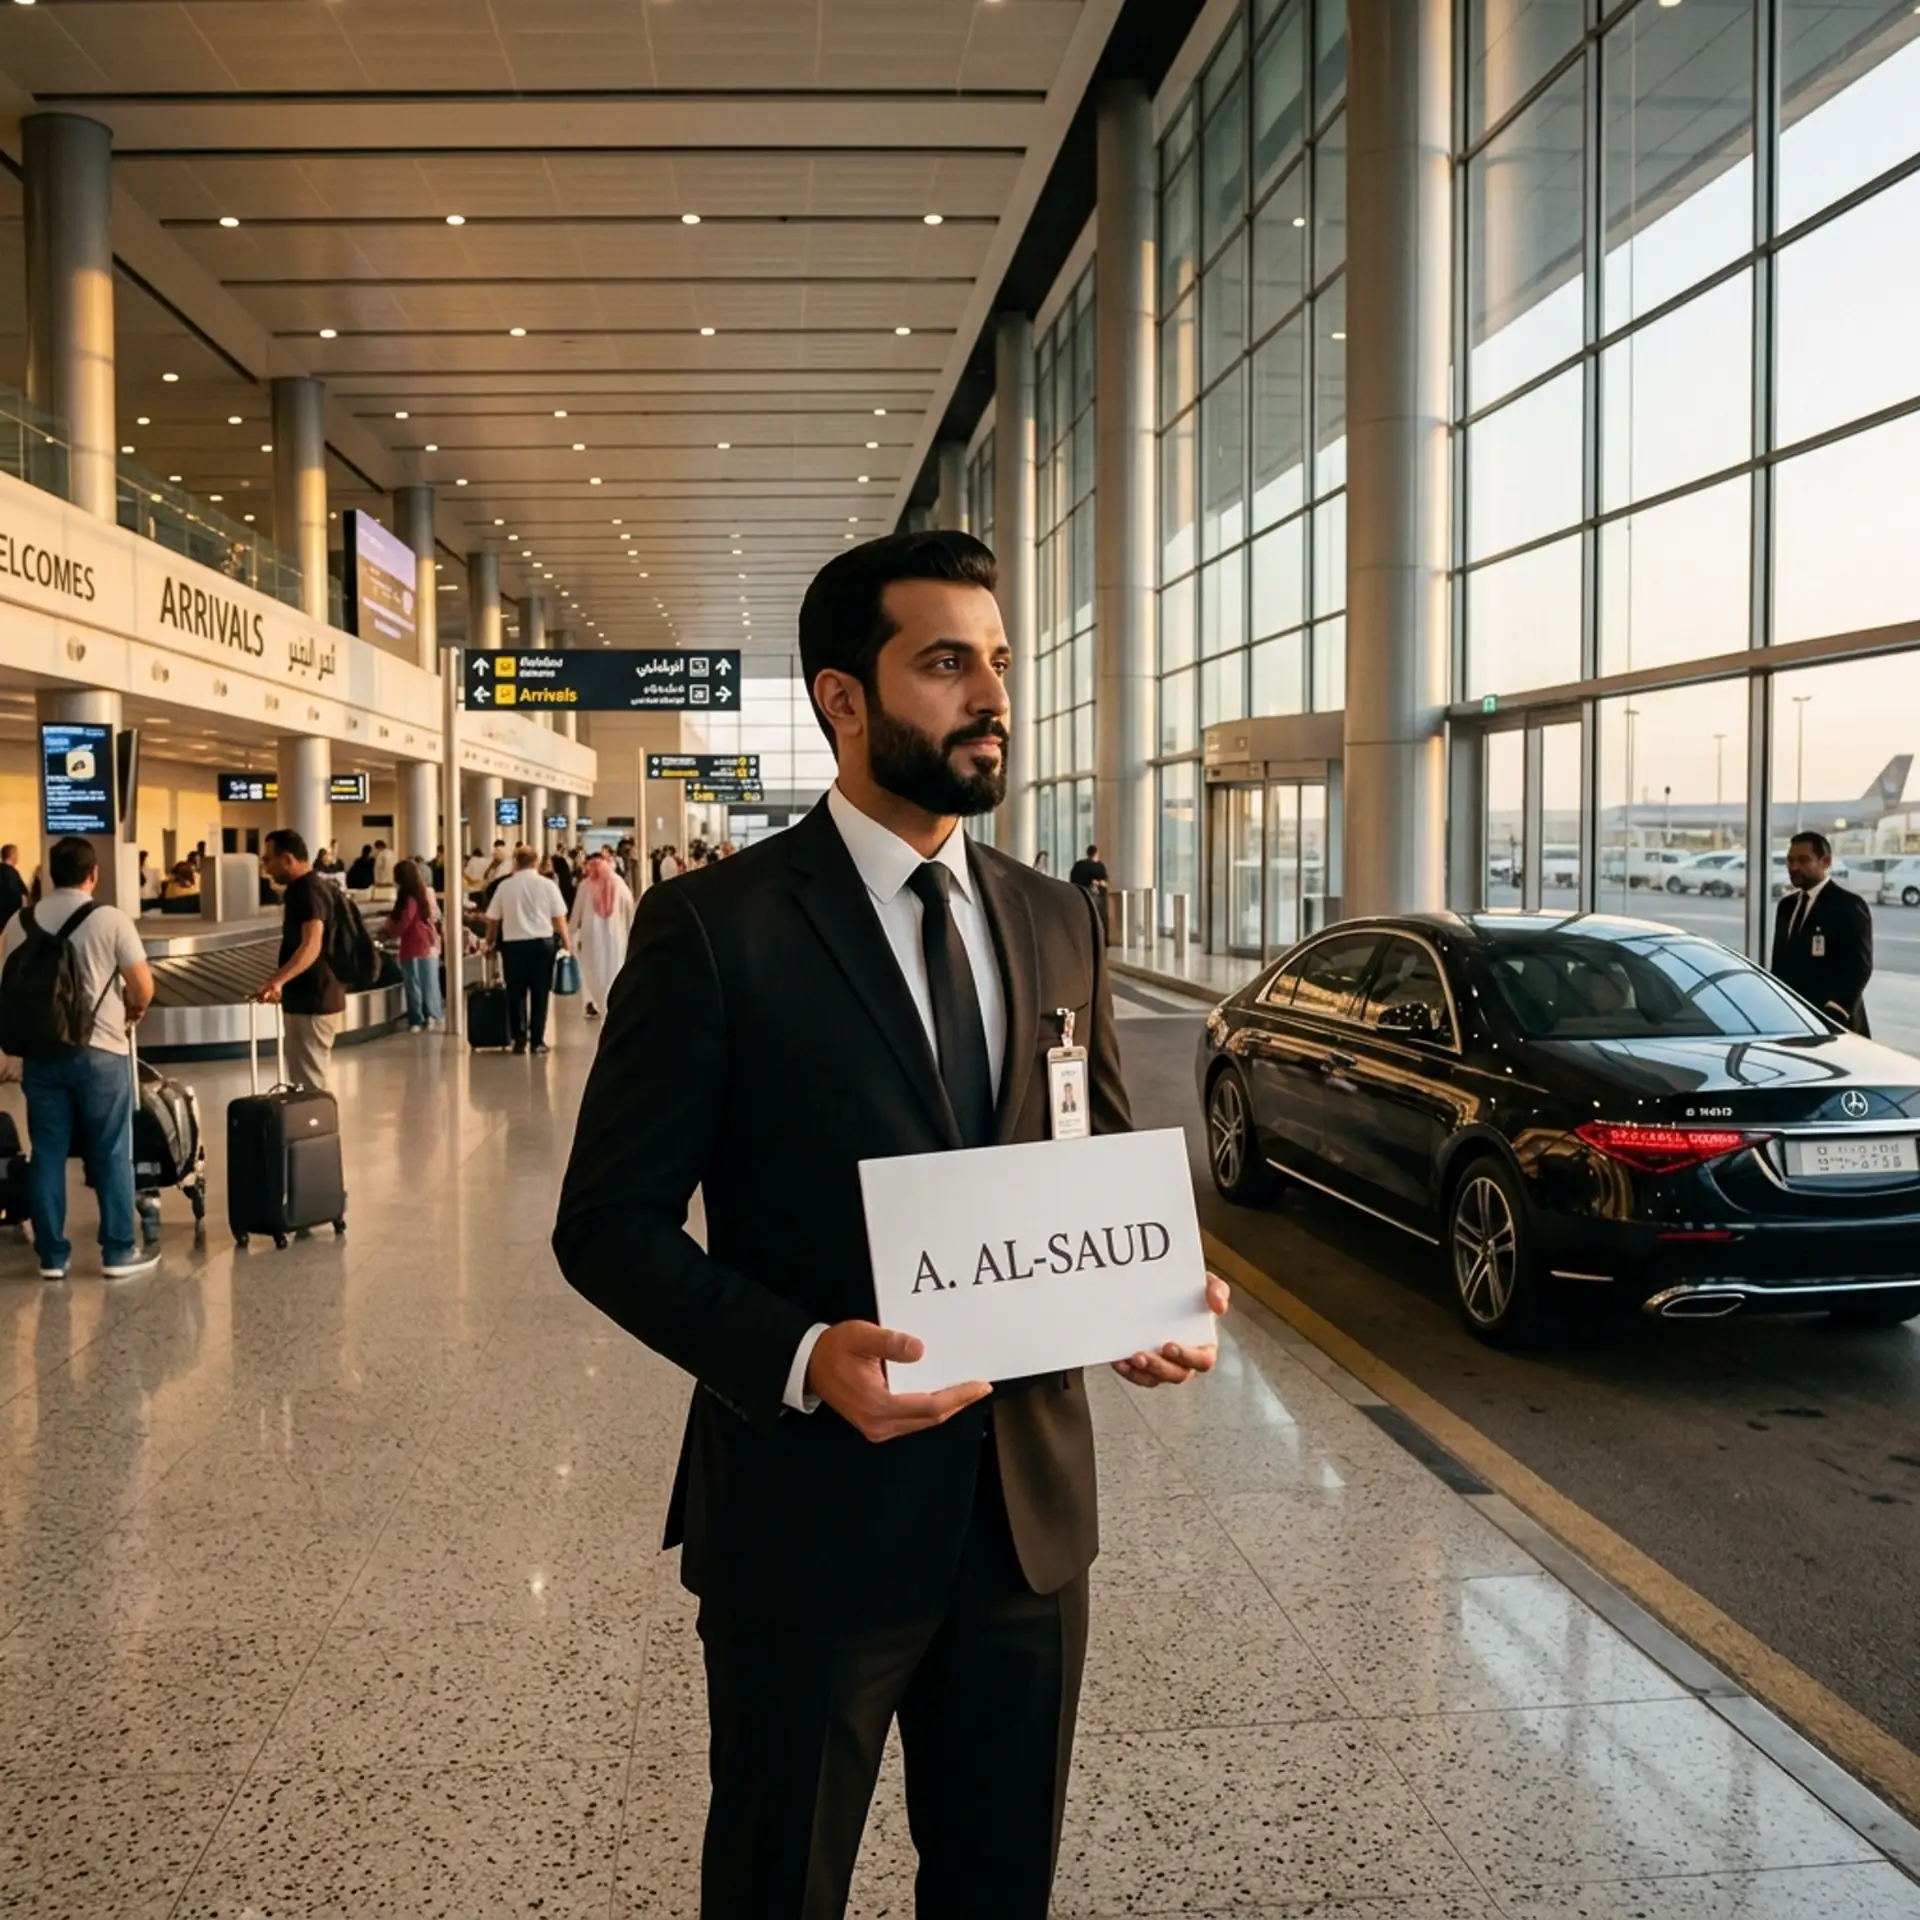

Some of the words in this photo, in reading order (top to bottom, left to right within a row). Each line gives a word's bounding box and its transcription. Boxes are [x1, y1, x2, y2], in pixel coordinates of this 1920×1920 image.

[160, 576, 264, 657] ARRIVALS
[911, 1250, 957, 1294] A.
[973, 1222, 1170, 1285] AL-SAUD
